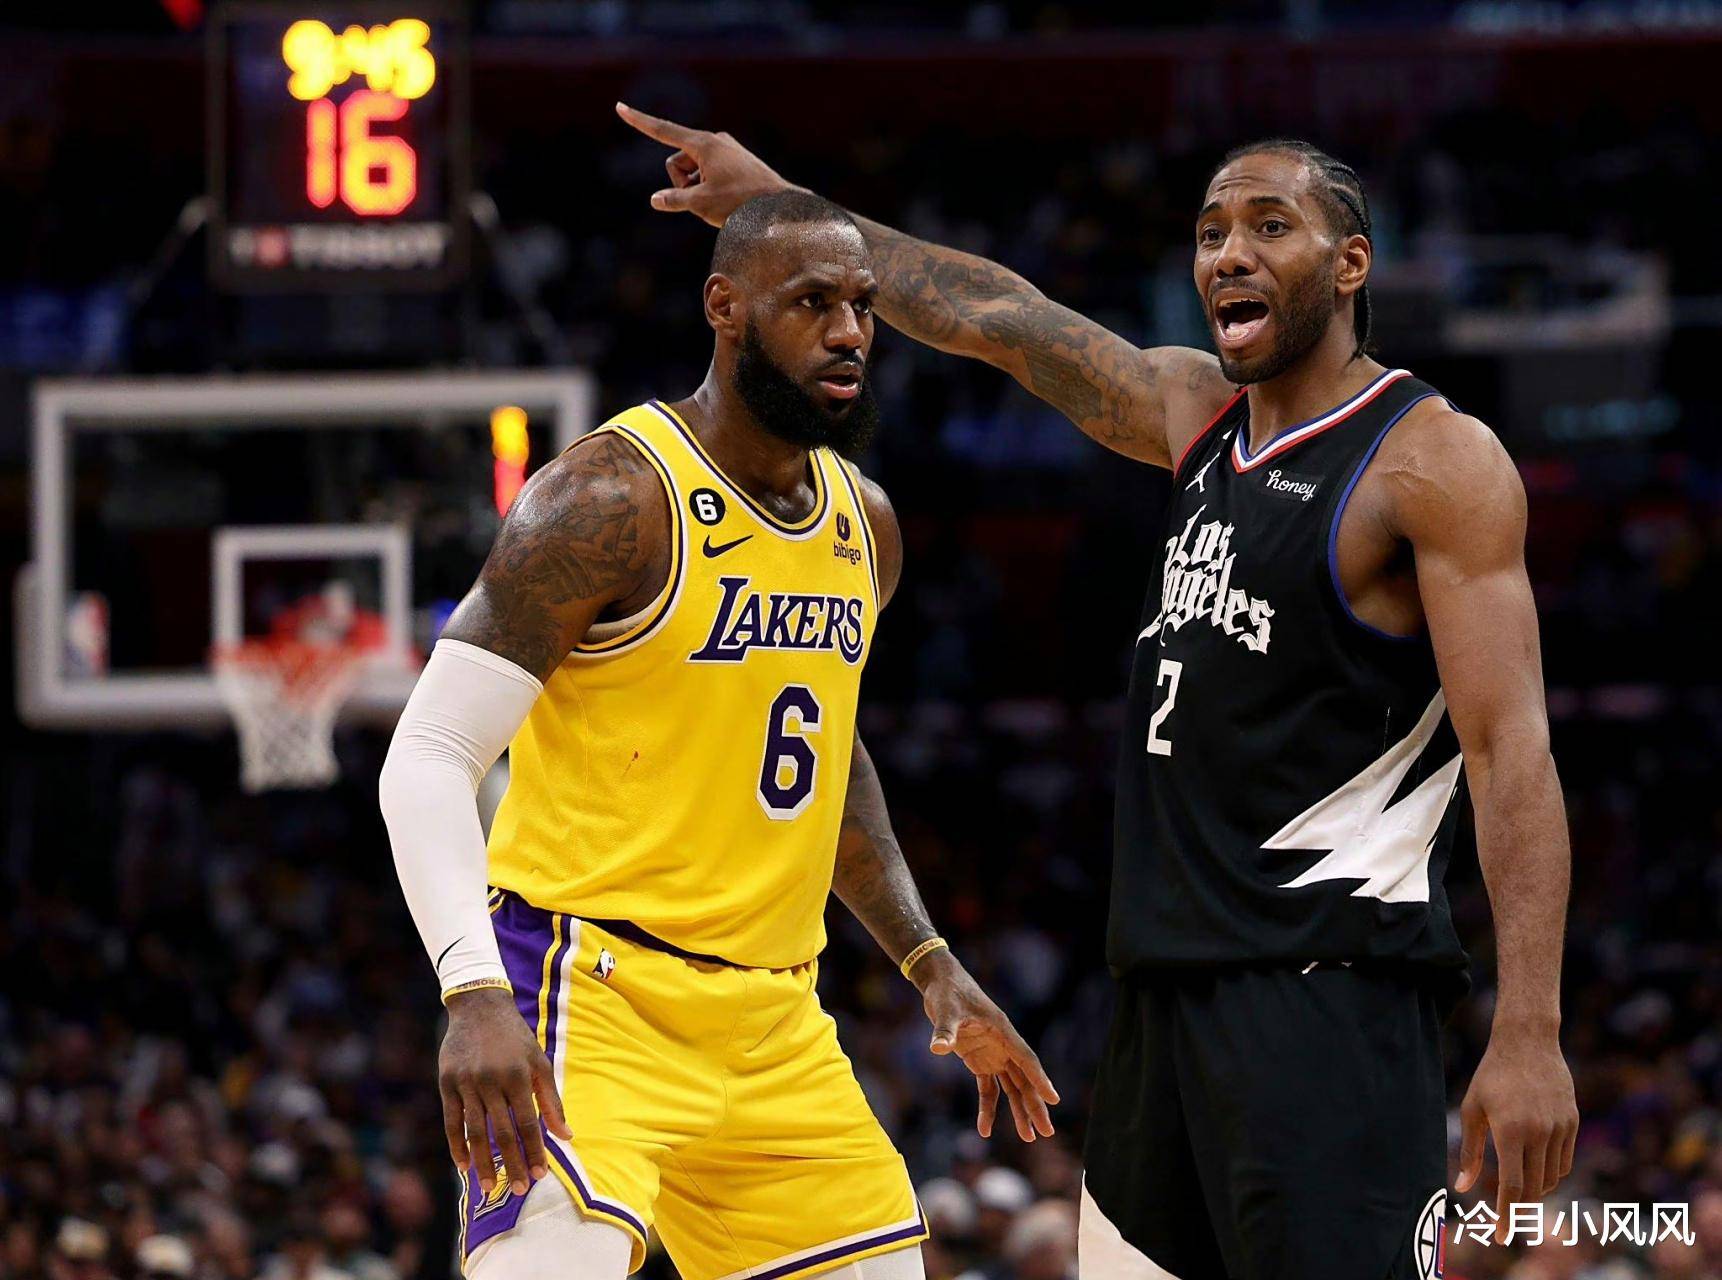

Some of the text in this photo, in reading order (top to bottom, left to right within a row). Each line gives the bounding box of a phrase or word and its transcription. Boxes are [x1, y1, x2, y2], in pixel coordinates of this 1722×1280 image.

[306, 88, 417, 216] 16
[695, 493, 717, 522] 6
[1266, 469, 1317, 501] honey
[833, 541, 862, 566] bibigo
[1165, 503, 1235, 573] Los
[685, 576, 865, 665] LAKERS
[1147, 659, 1183, 756] 2
[756, 682, 822, 821] 6
